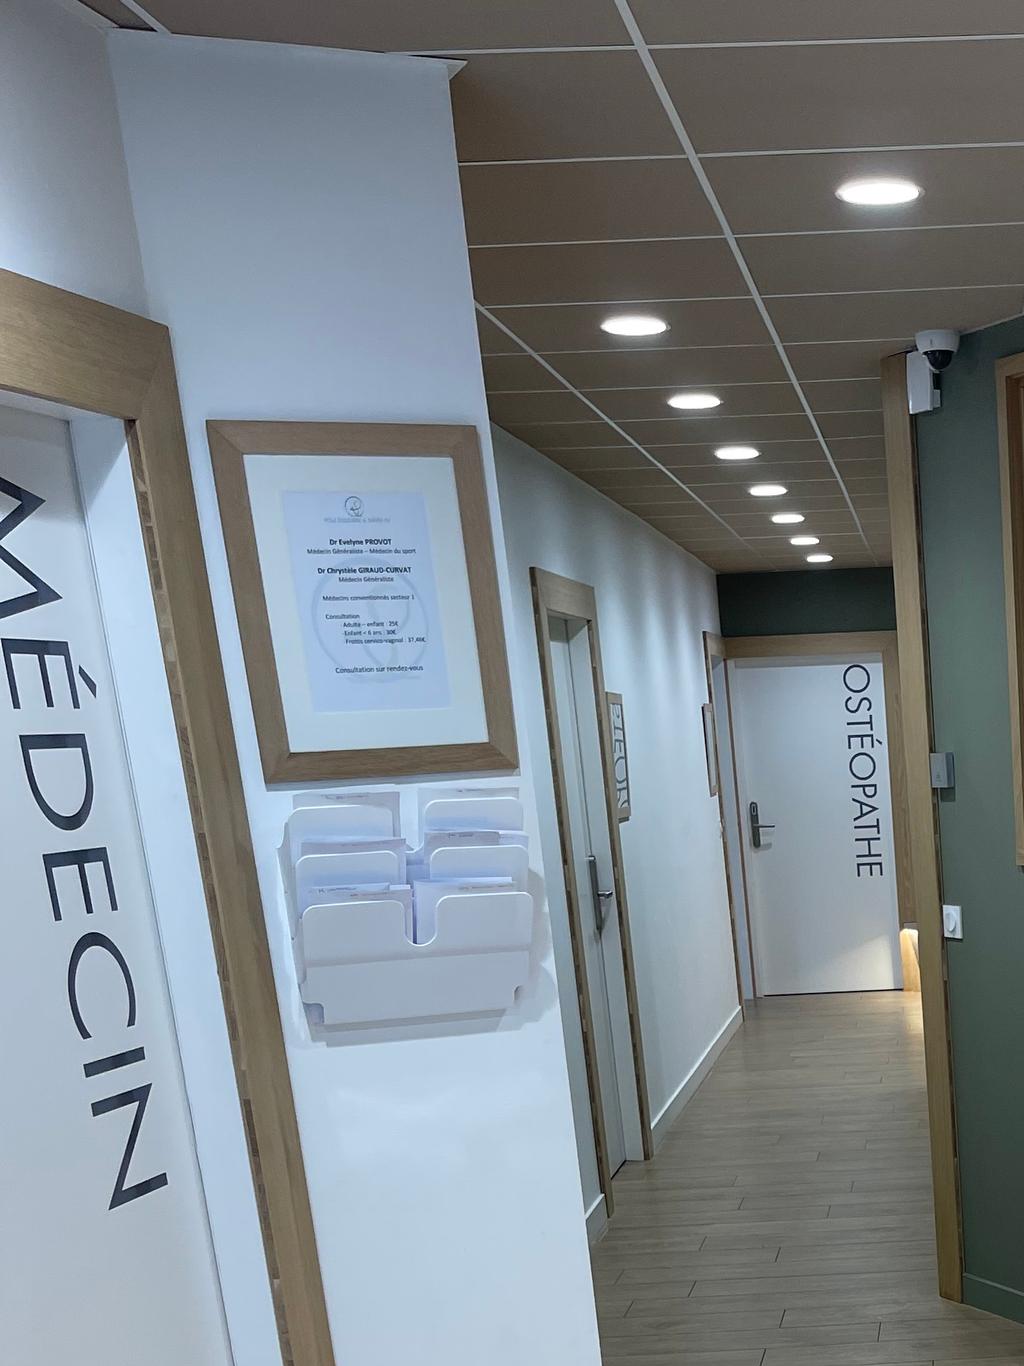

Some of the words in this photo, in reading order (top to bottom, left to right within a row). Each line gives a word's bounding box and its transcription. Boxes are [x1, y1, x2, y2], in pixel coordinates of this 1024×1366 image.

[339, 539, 363, 547] Evelyne
[336, 666, 374, 674] Consultation
[843, 663, 884, 878] OSTÉOPATHE
